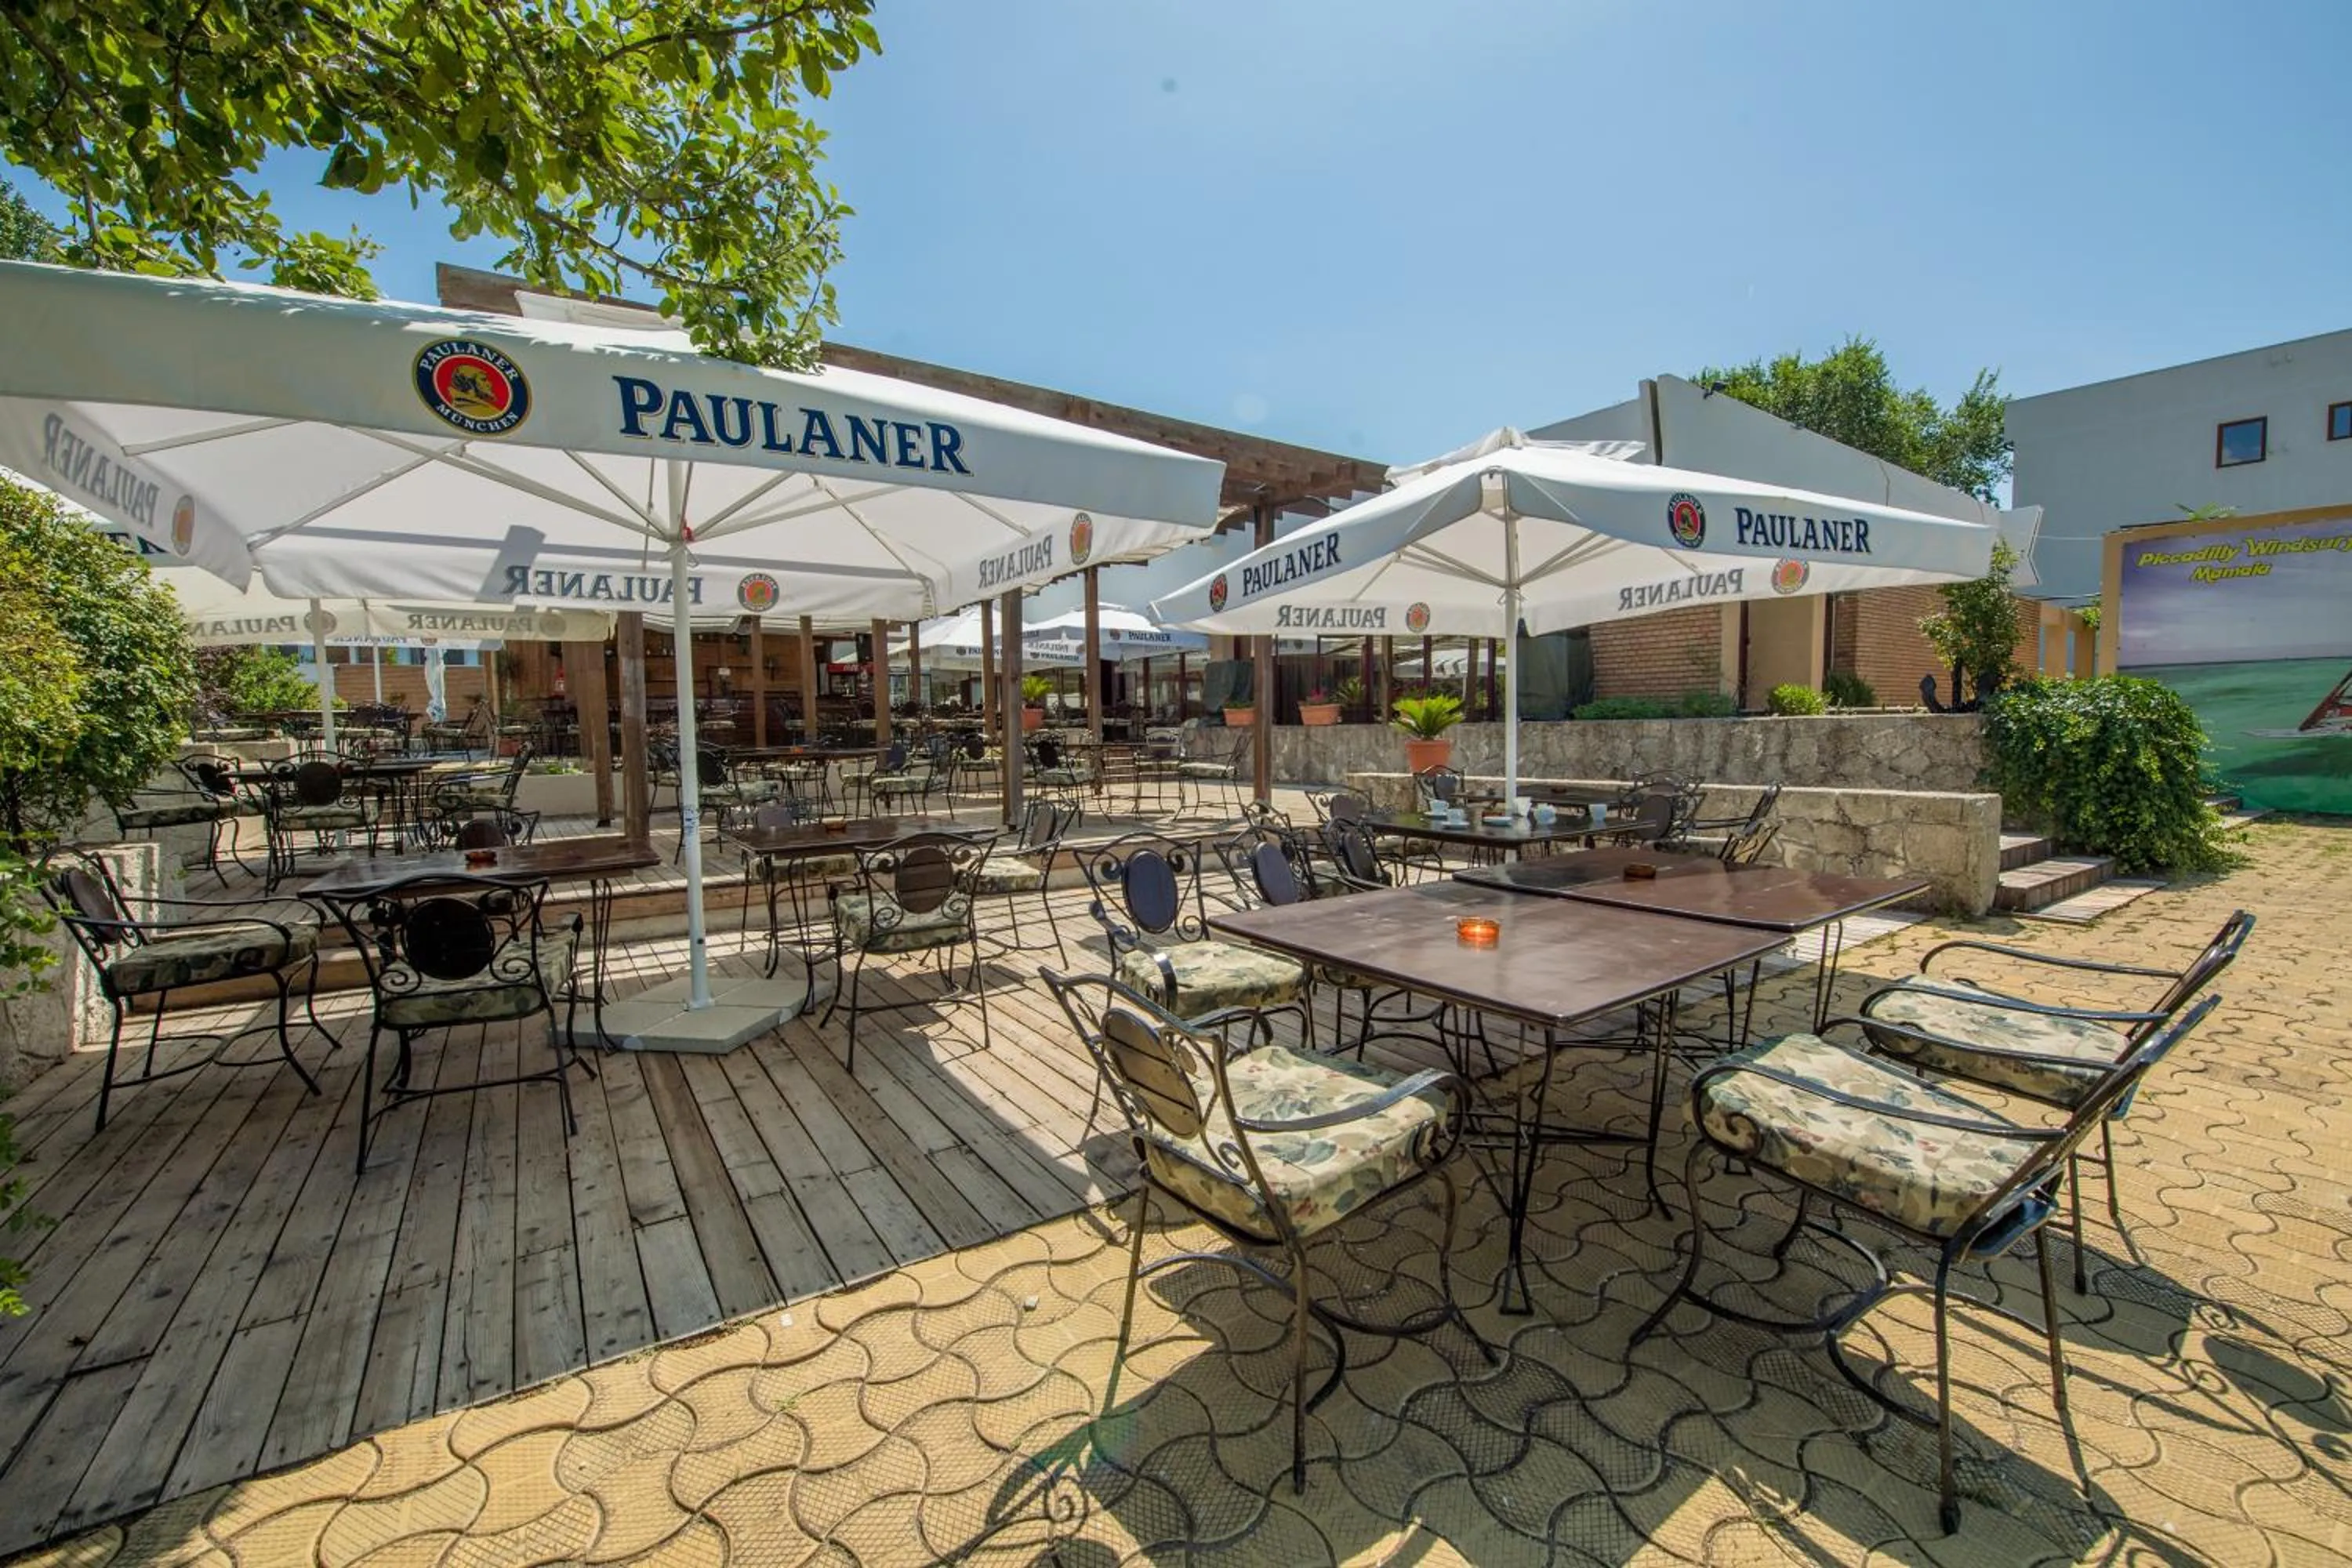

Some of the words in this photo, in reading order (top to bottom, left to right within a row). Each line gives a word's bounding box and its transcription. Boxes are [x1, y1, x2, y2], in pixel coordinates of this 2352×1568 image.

[419, 342, 519, 381] PAULANER
[612, 376, 974, 476] PAULANER
[1734, 507, 1871, 554] PAULANER
[1242, 532, 1341, 597] PAULANER
